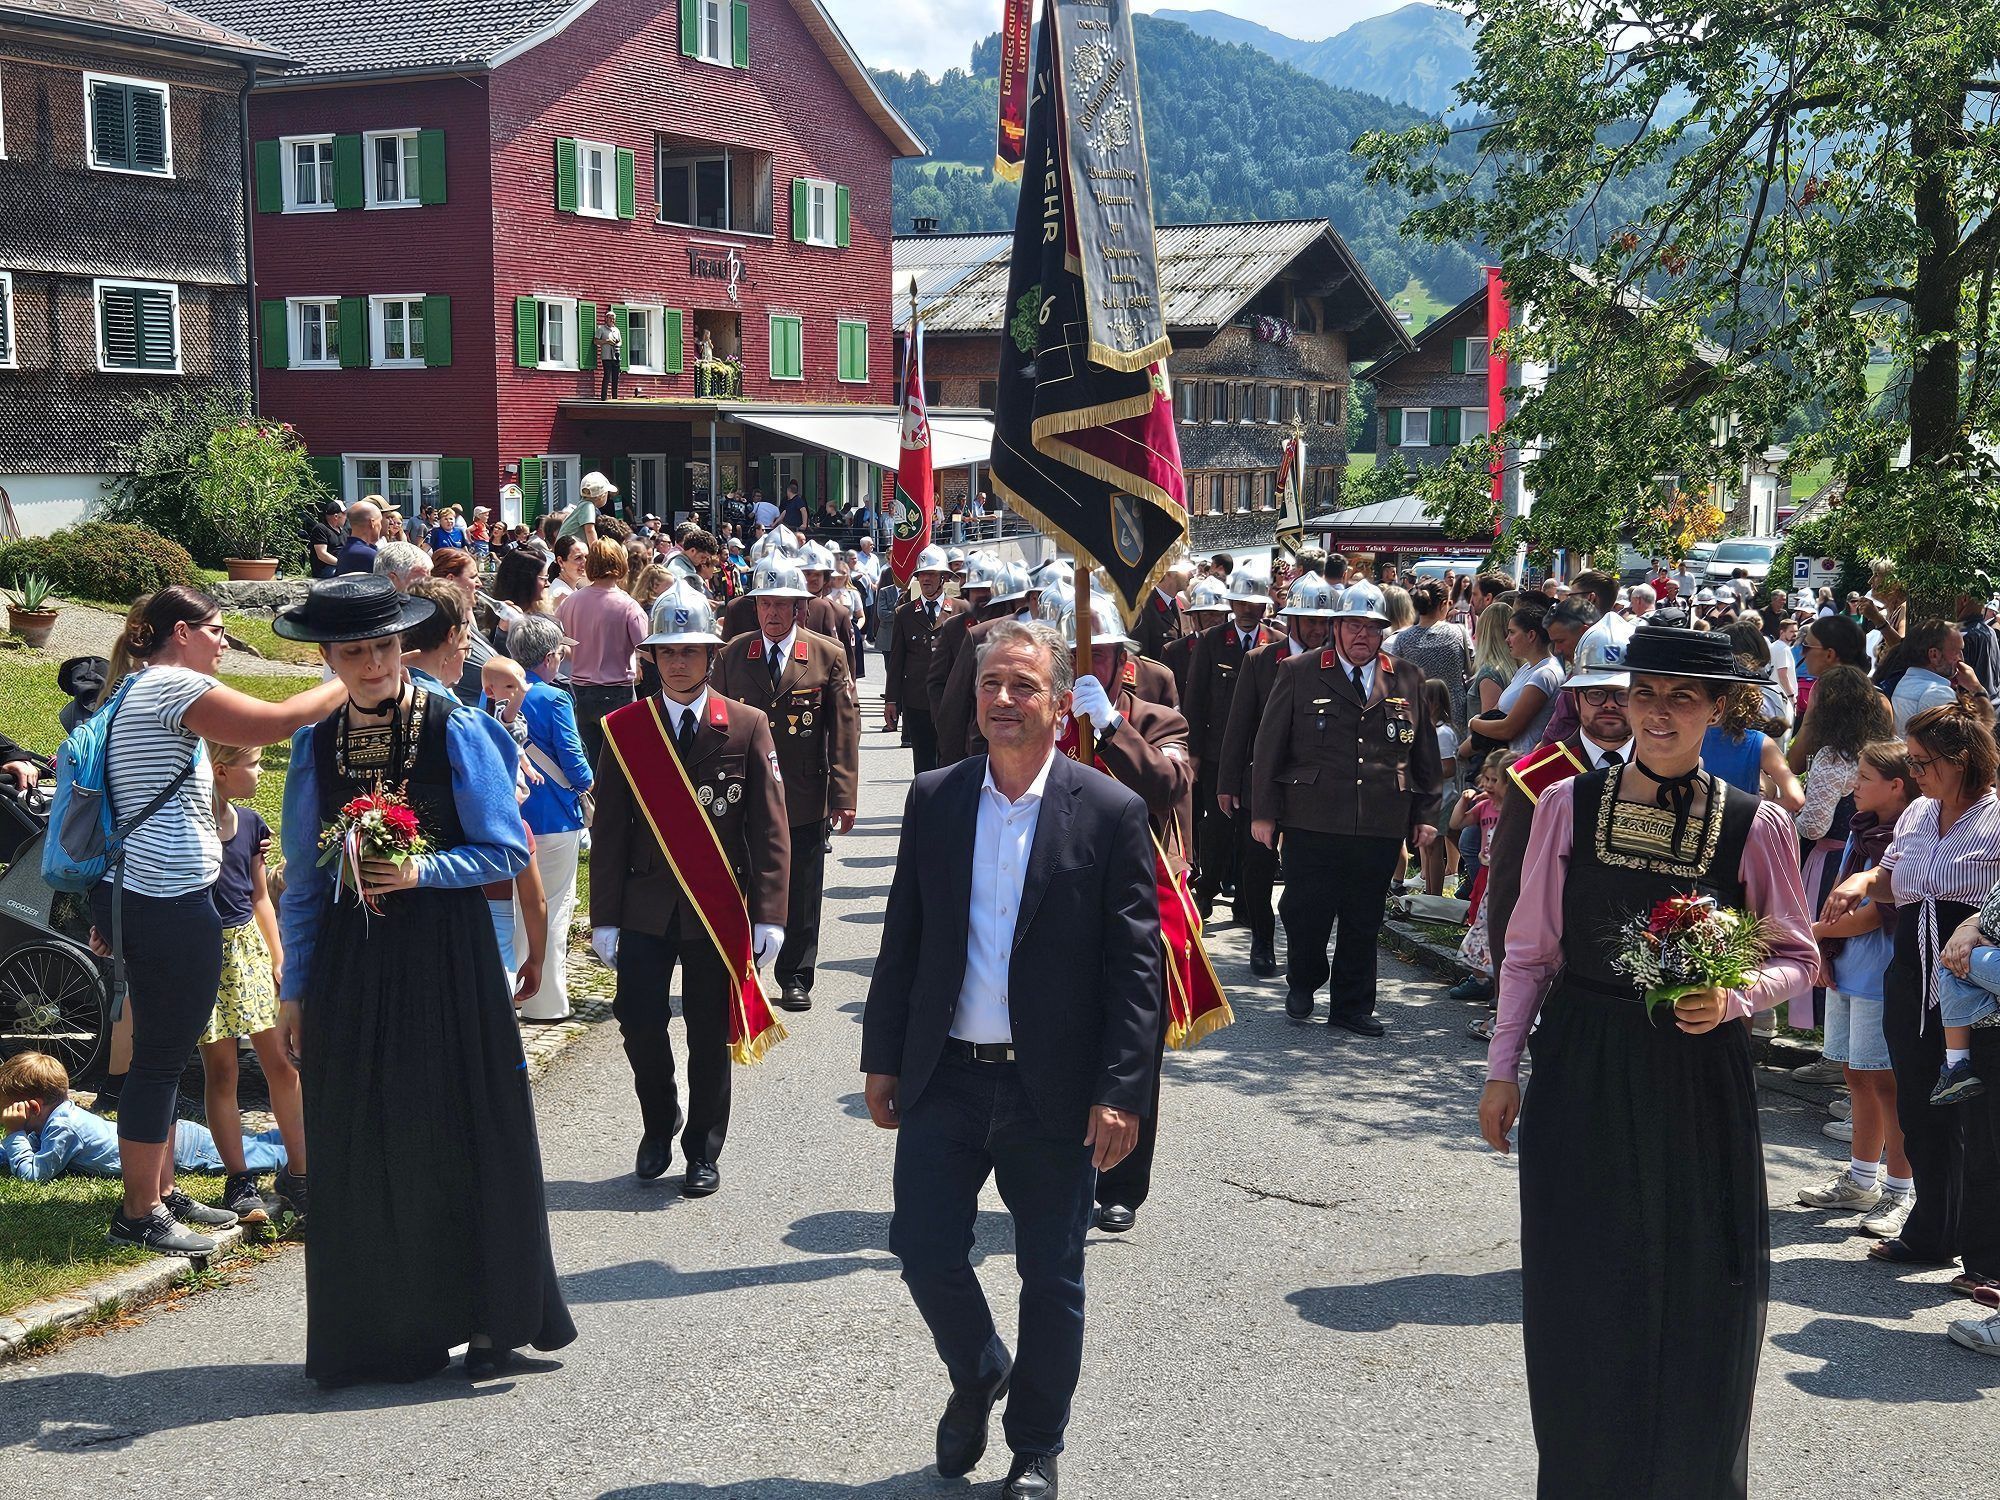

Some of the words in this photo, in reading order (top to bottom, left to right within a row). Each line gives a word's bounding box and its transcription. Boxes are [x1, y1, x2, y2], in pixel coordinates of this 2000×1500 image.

[1341, 544, 1360, 552] Lotto
[1392, 545, 1438, 553] Zeitschriften
[1795, 561, 1809, 576] P
[6, 899, 39, 917] CROOZER
